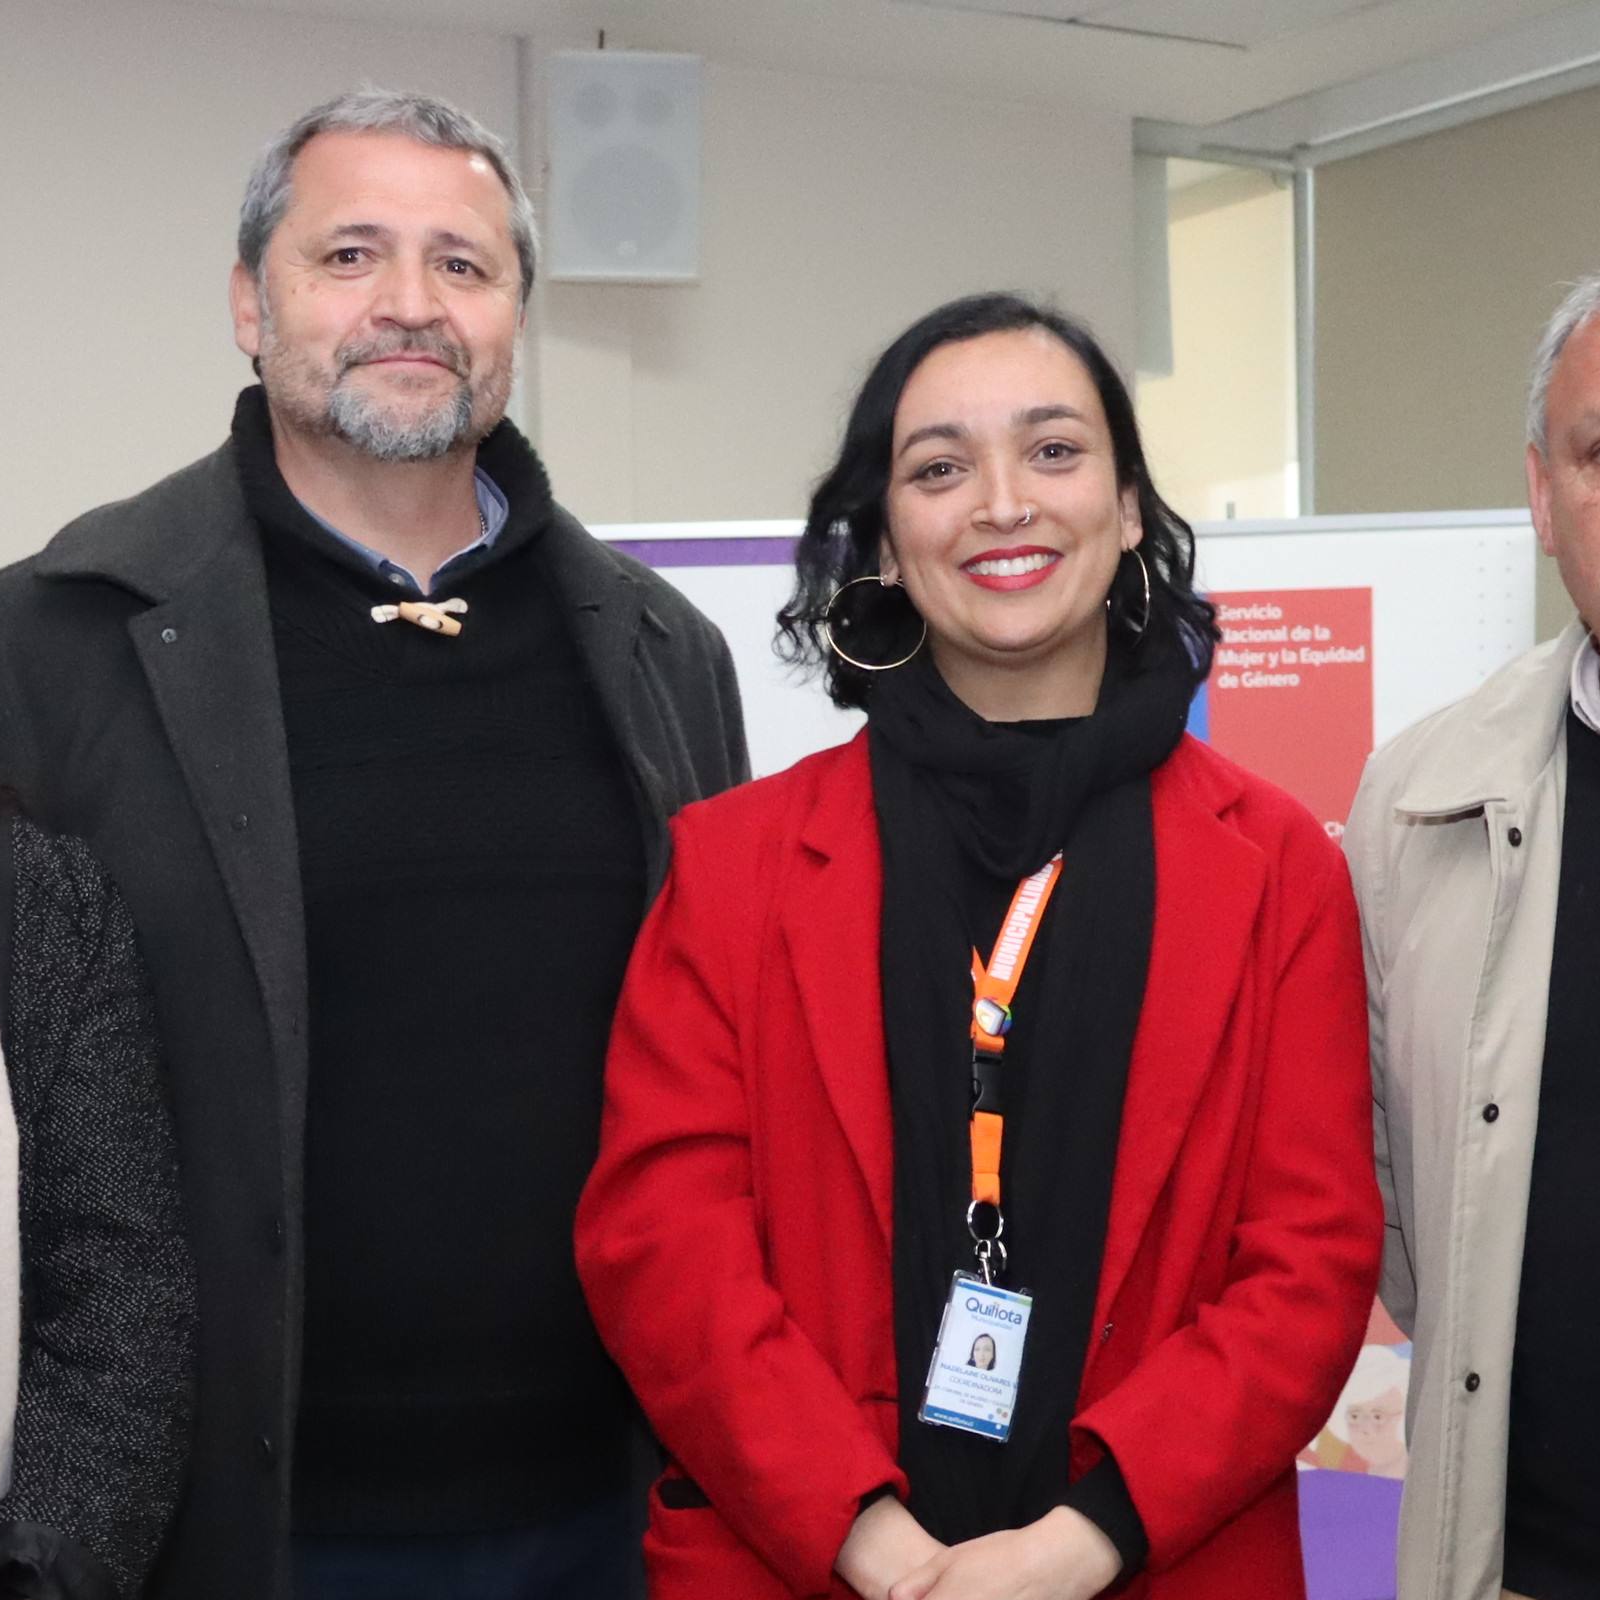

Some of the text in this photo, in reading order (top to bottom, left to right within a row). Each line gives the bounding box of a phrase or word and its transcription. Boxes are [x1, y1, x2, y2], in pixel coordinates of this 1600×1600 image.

[1218, 602, 1283, 621] Servicio
[1290, 624, 1313, 643] de
[1314, 623, 1332, 642] la
[1217, 645, 1366, 669] Mujer y la Equidad
[1217, 670, 1300, 689] de Género
[965, 1297, 1022, 1325] Quillota
